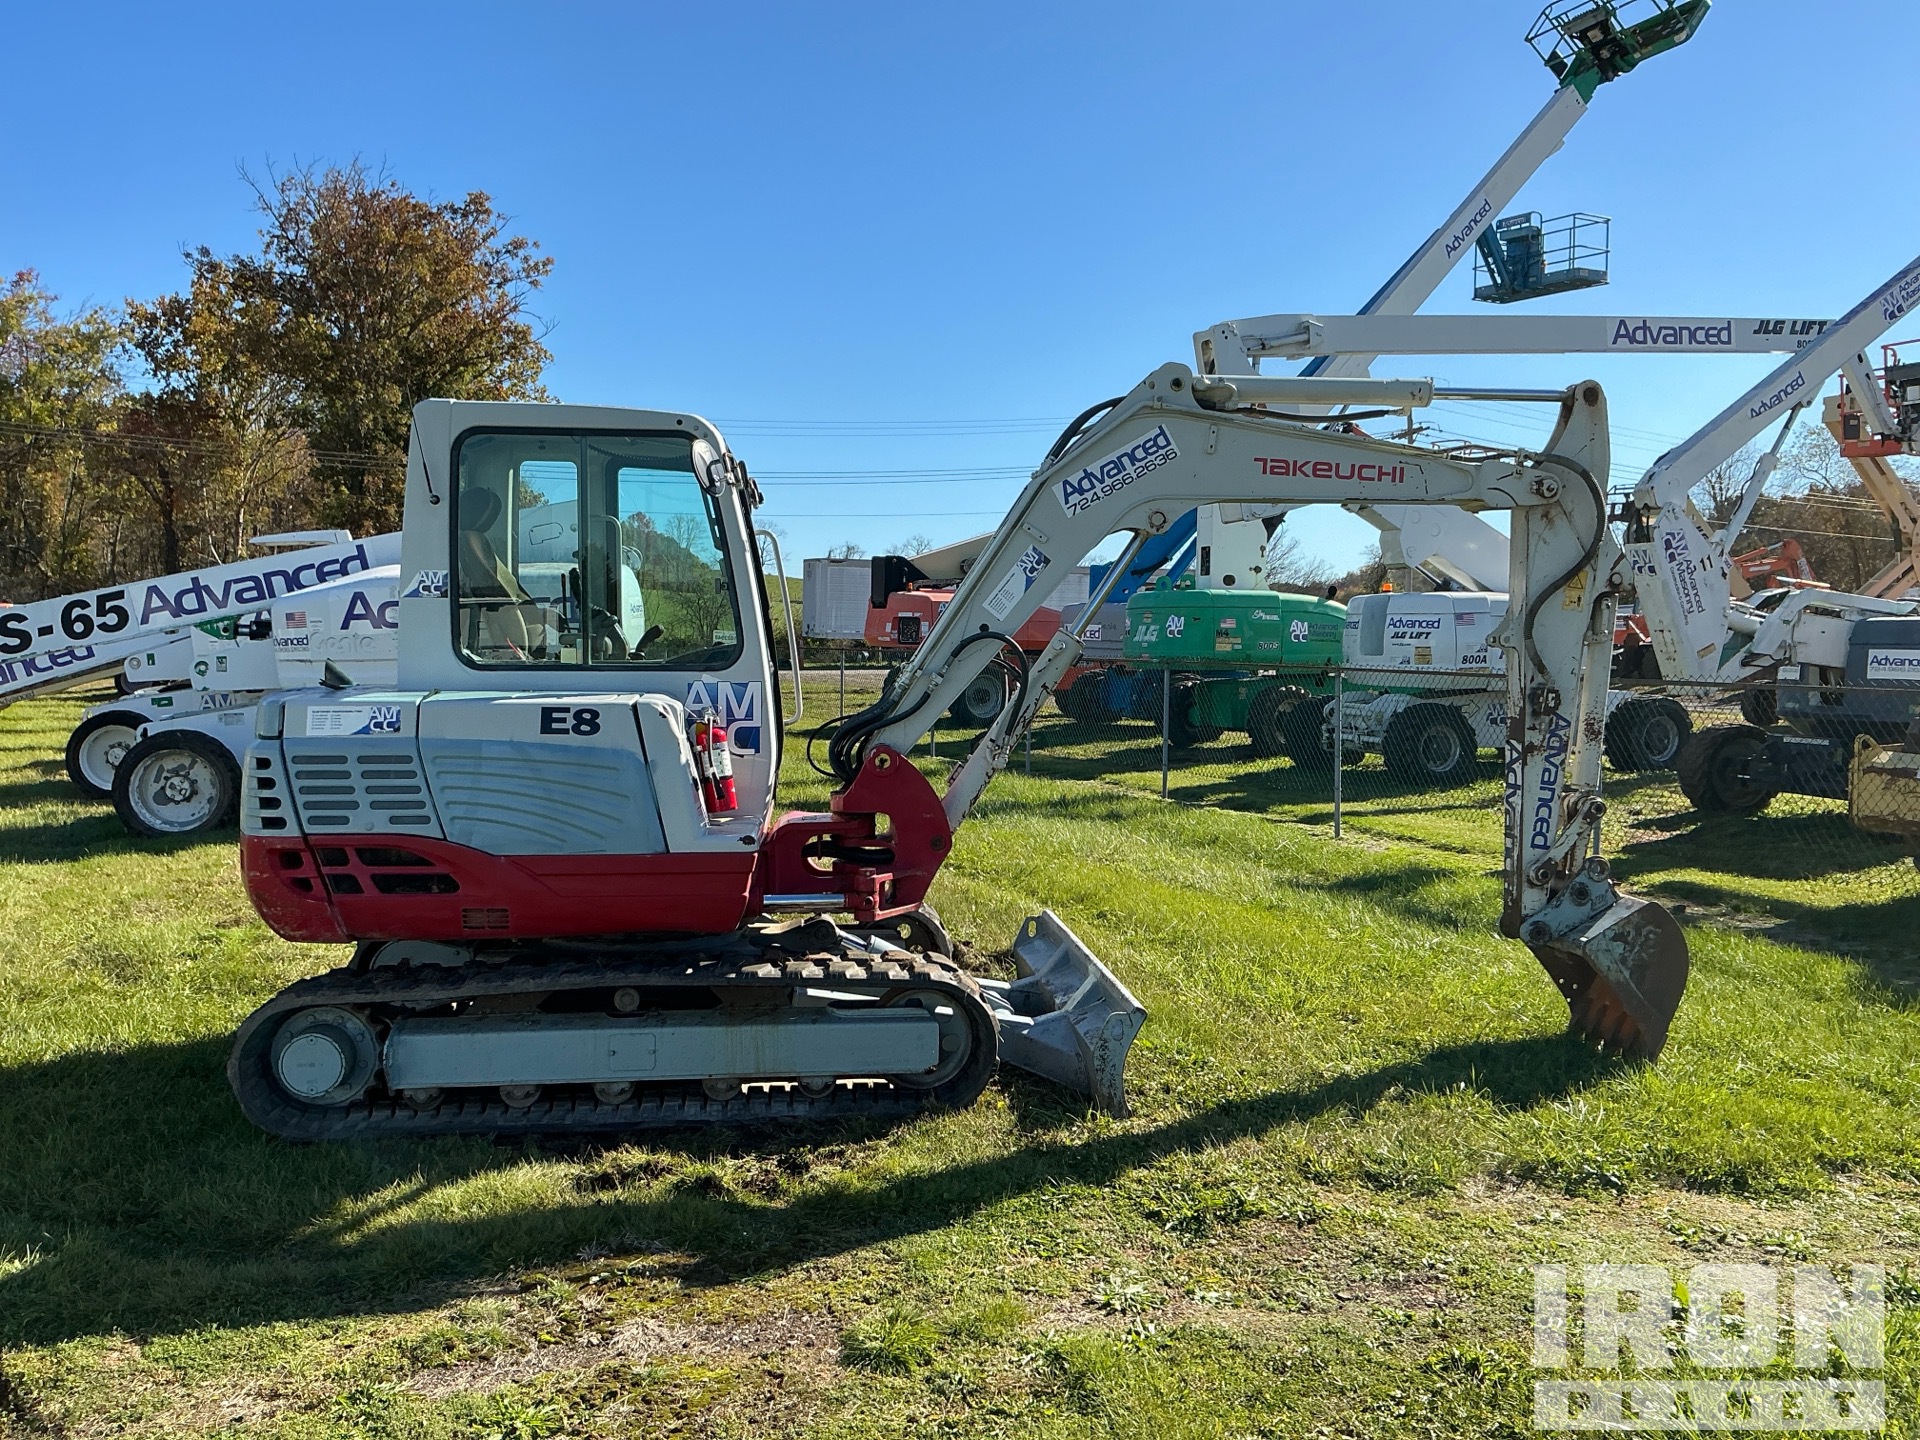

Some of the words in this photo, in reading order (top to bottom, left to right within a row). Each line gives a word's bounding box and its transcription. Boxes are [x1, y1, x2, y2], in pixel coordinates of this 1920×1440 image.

[1445, 198, 1492, 259] Advanced
[1612, 319, 1731, 345] Advanced
[1753, 320, 1785, 335] JLG
[1789, 320, 1828, 335] LIFT
[1750, 371, 1806, 419] Advanced
[1062, 425, 1171, 505] Advanced
[1067, 448, 1178, 516] 724.966.2636
[1017, 550, 1039, 570] AM
[1026, 558, 1045, 577] CC
[140, 543, 370, 626] Advanced
[419, 570, 442, 586] AM
[1684, 559, 1706, 613] Advanced
[419, 583, 442, 594] CC
[1676, 561, 1695, 614] Masonry
[1165, 614, 1185, 630] AM
[1290, 620, 1308, 634] AM
[1387, 617, 1441, 630] Advanced
[1166, 628, 1182, 638] CC
[1291, 632, 1307, 642] CC
[1391, 631, 1408, 640] JLG
[1409, 631, 1432, 640] LIFT
[1258, 642, 1279, 651] 800S
[1461, 655, 1487, 665] 800A
[1870, 655, 1920, 667] Advanc
[200, 693, 236, 710] AM
[370, 706, 397, 721] AM
[540, 706, 601, 736] E8
[370, 719, 395, 731] CC
[1530, 711, 1572, 851] Advanced
